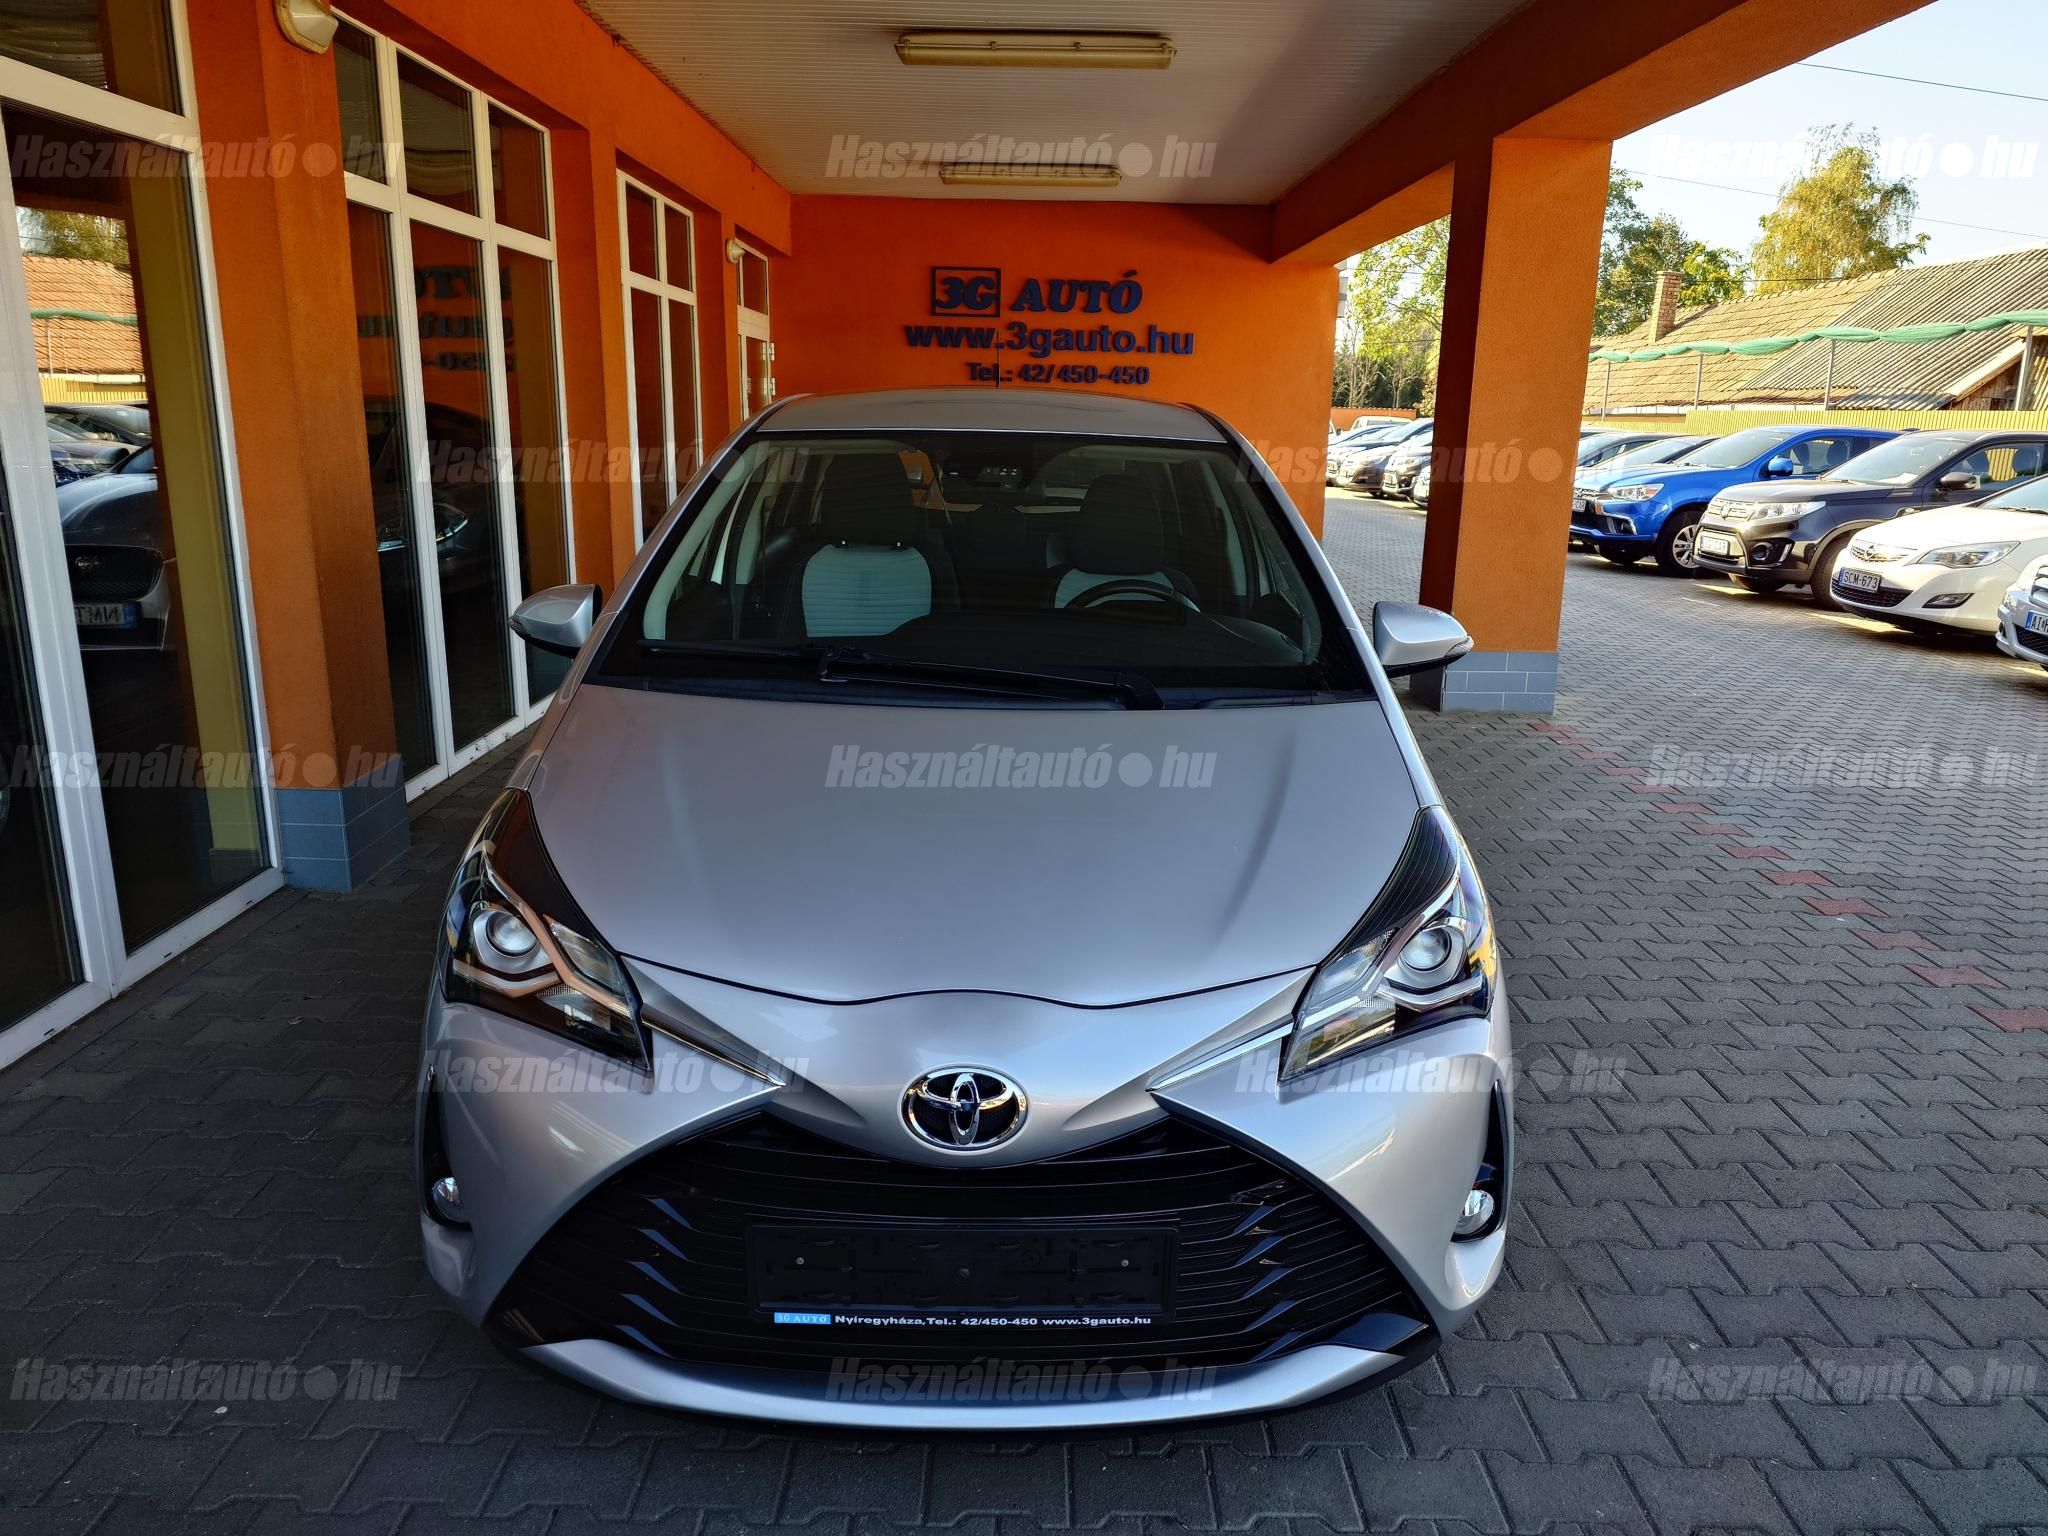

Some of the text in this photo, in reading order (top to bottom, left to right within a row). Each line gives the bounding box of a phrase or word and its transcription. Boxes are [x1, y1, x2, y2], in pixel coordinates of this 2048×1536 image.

[934, 269, 1143, 313] 3G AUTÓ
[905, 321, 1194, 358] www.3gauto.hu
[966, 362, 1012, 384] Tel.:
[1844, 571, 1878, 589] SCM-673
[960, 1317, 1038, 1326] 42/450-450
[1042, 1316, 1151, 1327] www.3gauto.hu
